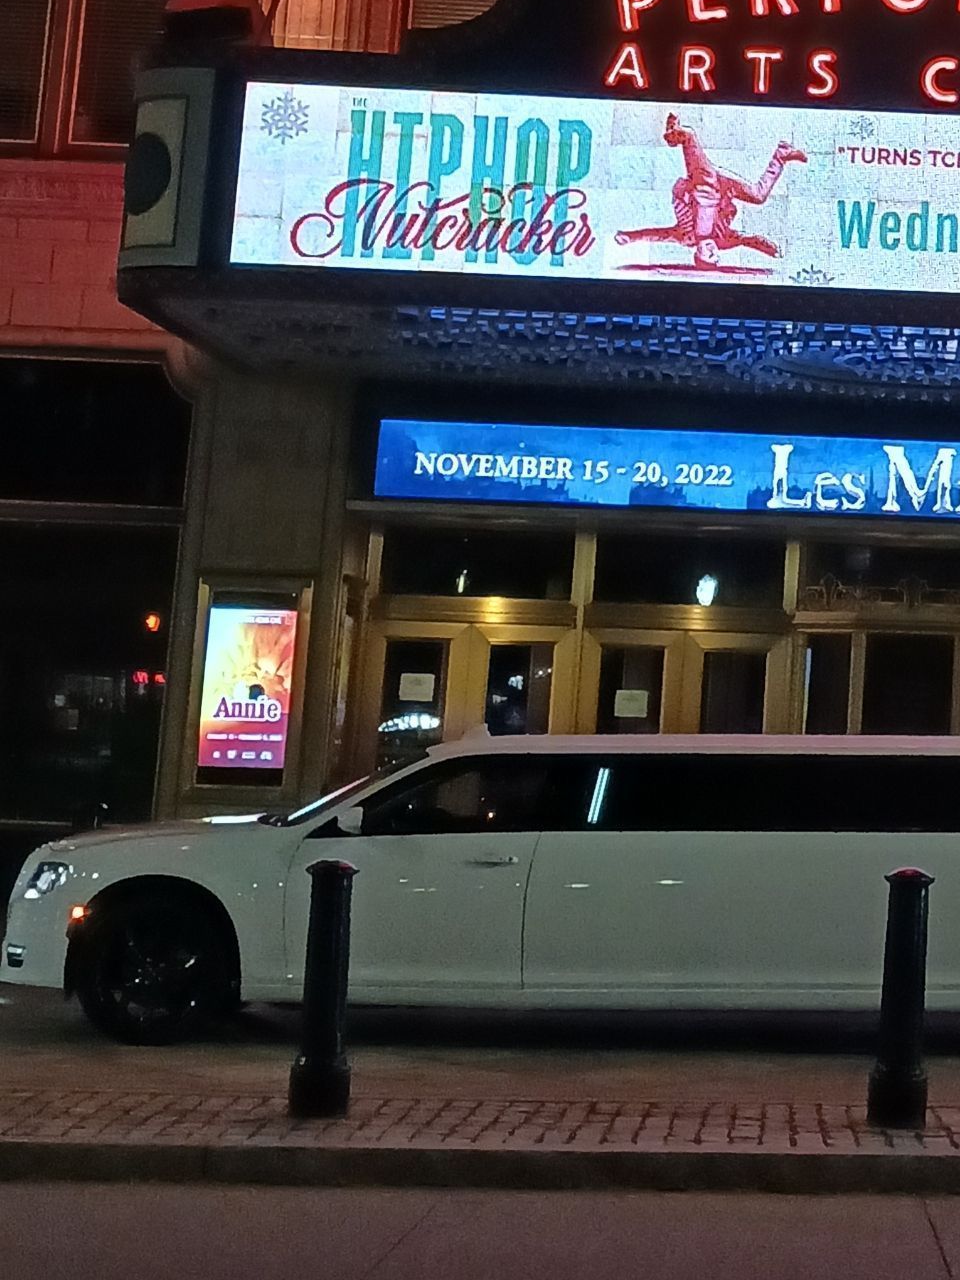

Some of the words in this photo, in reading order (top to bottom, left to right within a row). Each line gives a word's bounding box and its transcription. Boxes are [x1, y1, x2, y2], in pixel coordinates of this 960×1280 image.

[603, 42, 839, 98] ARTS
[838, 146, 922, 166] "TURNS
[289, 177, 596, 258] Nutcracker
[413, 451, 575, 481] NOVEMBER
[582, 461, 609, 483] 15
[631, 462, 669, 487] 20,
[674, 464, 735, 487] 2022
[766, 442, 867, 512] Les
[212, 696, 279, 719] Annie
